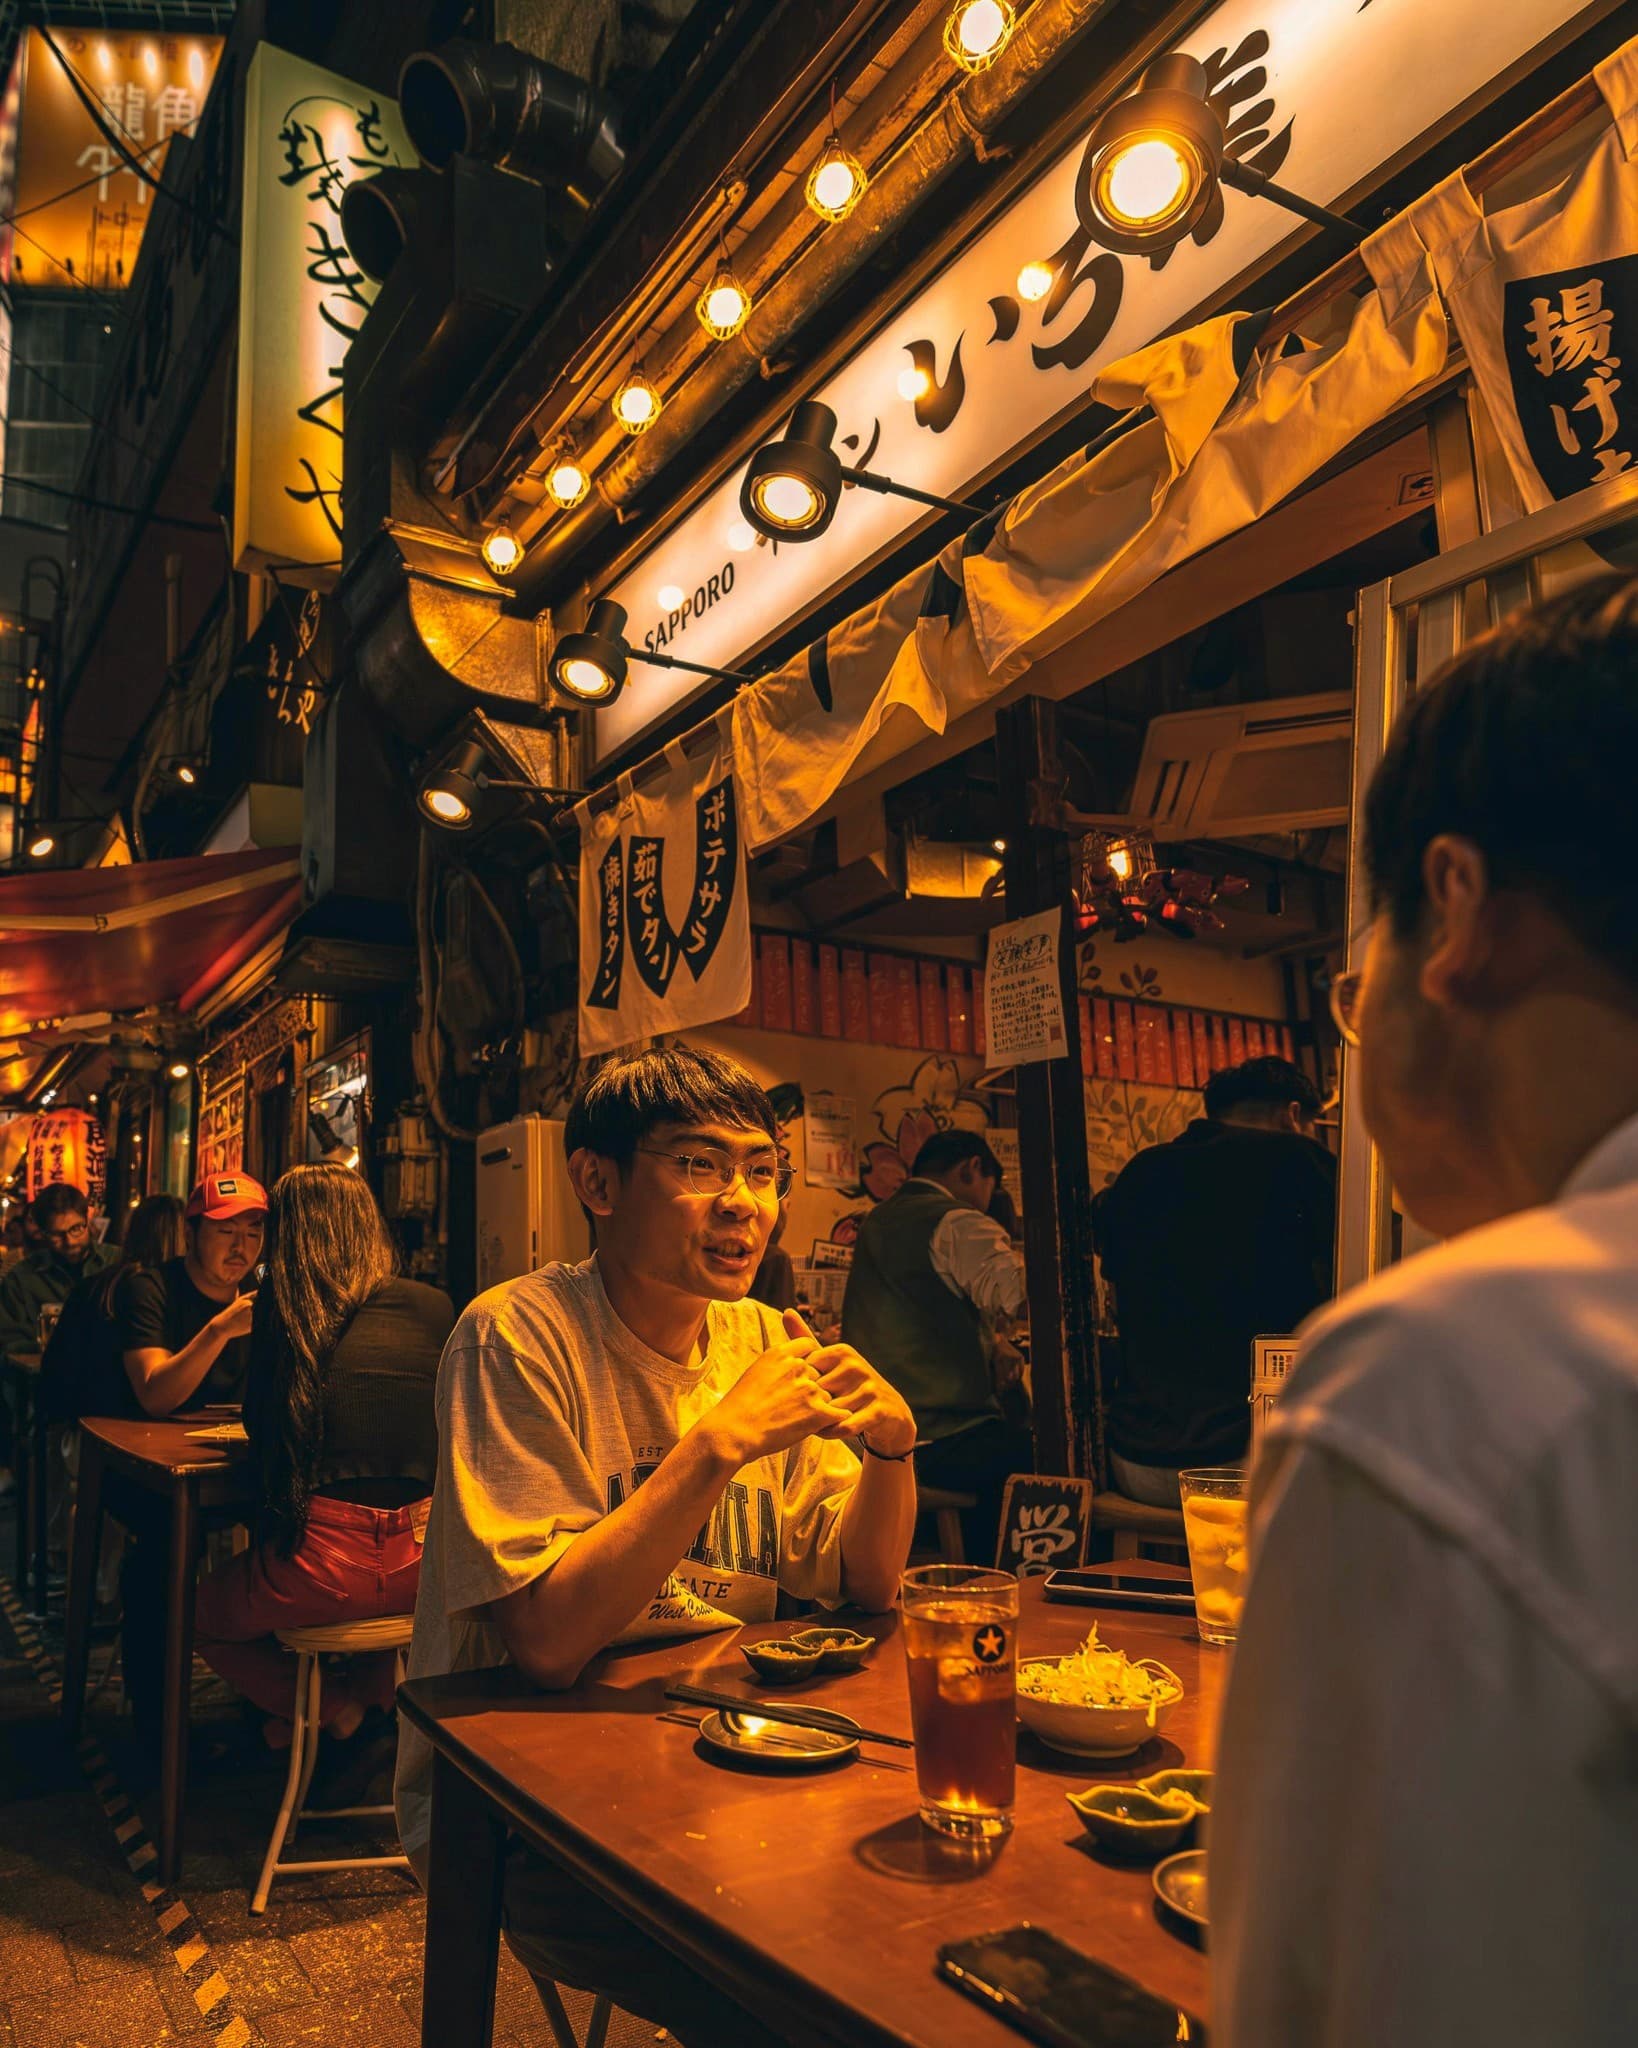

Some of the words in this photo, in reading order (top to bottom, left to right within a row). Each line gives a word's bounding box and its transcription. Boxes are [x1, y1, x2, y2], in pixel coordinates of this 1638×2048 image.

[644, 561, 736, 656] SAPPORO
[602, 855, 622, 1000] 焼きタン
[633, 841, 671, 982] 茹でタン
[686, 787, 728, 955] ポテサラ
[648, 1602, 686, 1621] West
